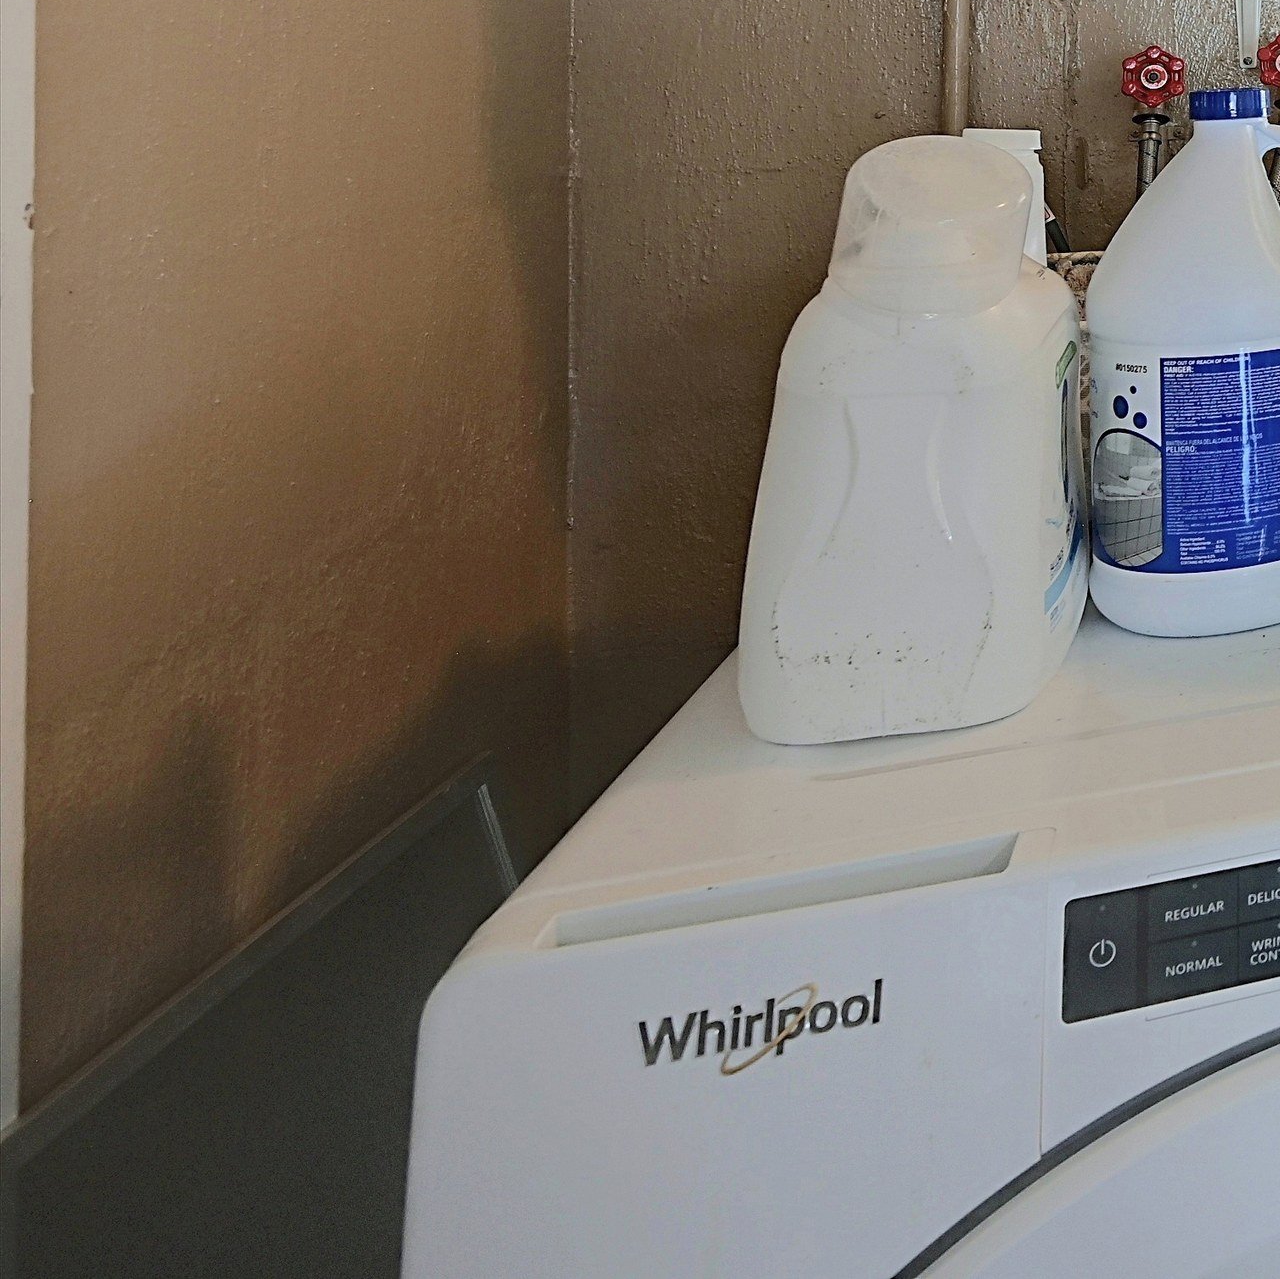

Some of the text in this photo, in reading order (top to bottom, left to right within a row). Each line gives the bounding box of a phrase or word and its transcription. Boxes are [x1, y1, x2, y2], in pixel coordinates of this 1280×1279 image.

[1115, 362, 1148, 374] #0150275
[1164, 900, 1225, 922] REGULAR
[1165, 955, 1224, 978] NORMAL
[638, 978, 883, 1066] Whirlpool
